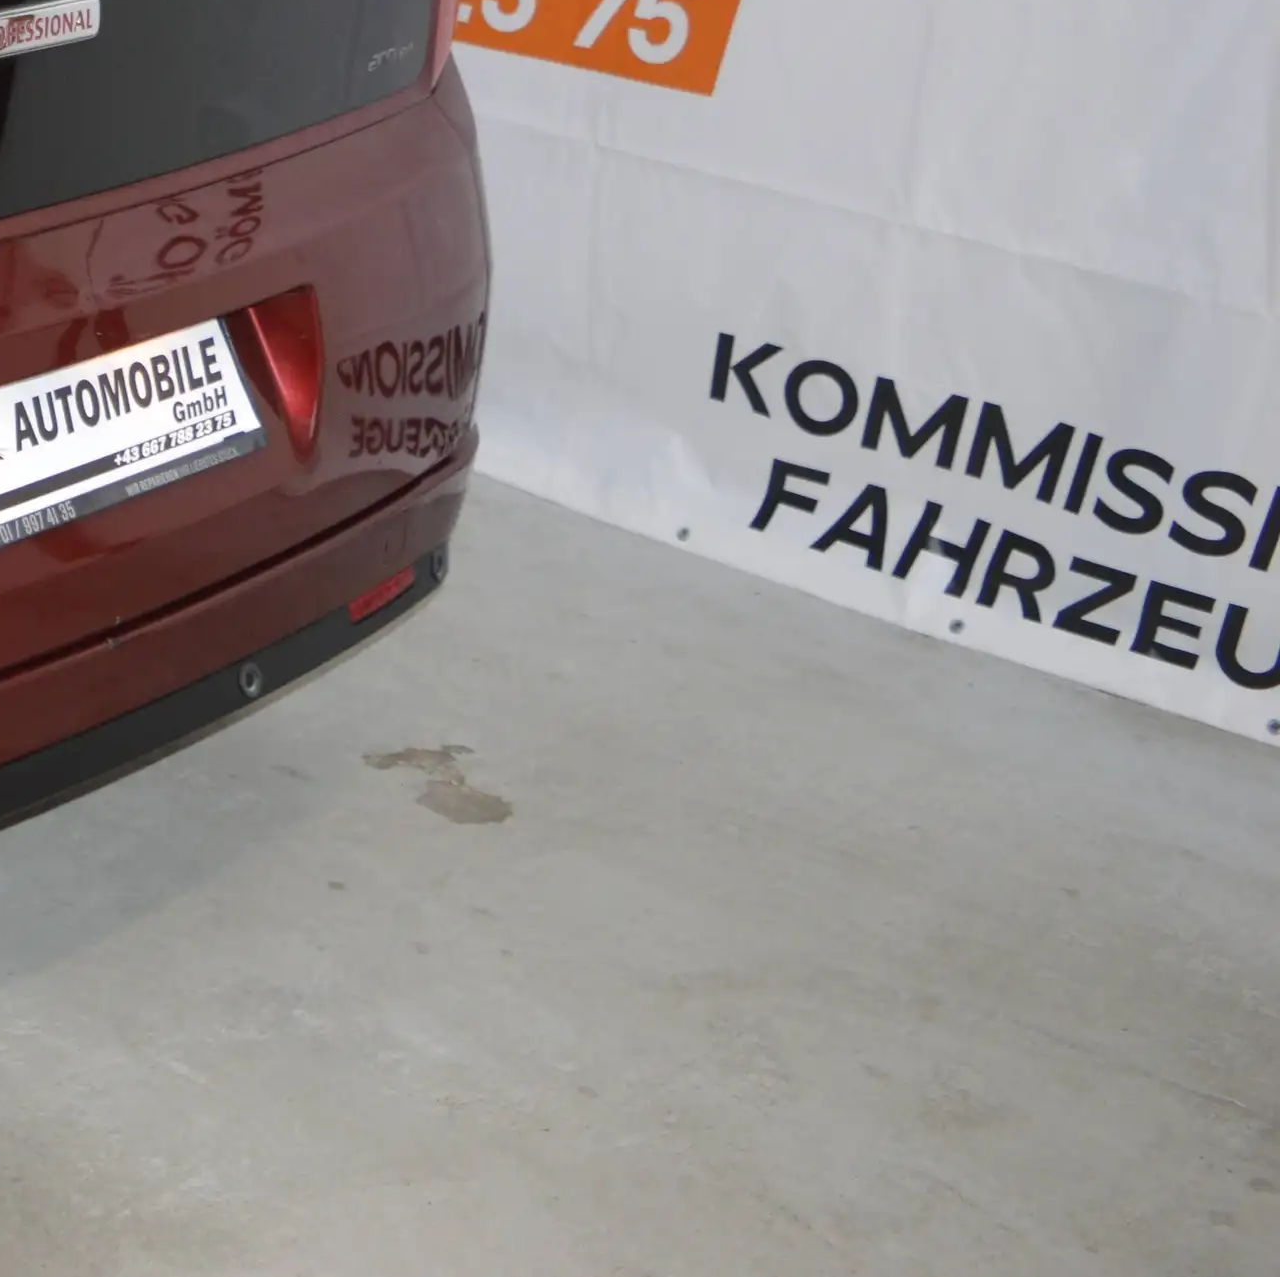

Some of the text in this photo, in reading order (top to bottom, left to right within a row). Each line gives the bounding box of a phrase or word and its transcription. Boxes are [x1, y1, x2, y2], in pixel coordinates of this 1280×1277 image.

[14, 337, 223, 453] AUTOMOBILE
[172, 385, 228, 423] GmbH
[114, 411, 233, 466] +43 667 788 23 75
[23, 509, 45, 536] 997
[60, 500, 77, 522] 35
[749, 458, 1280, 691] FAHRZEU
